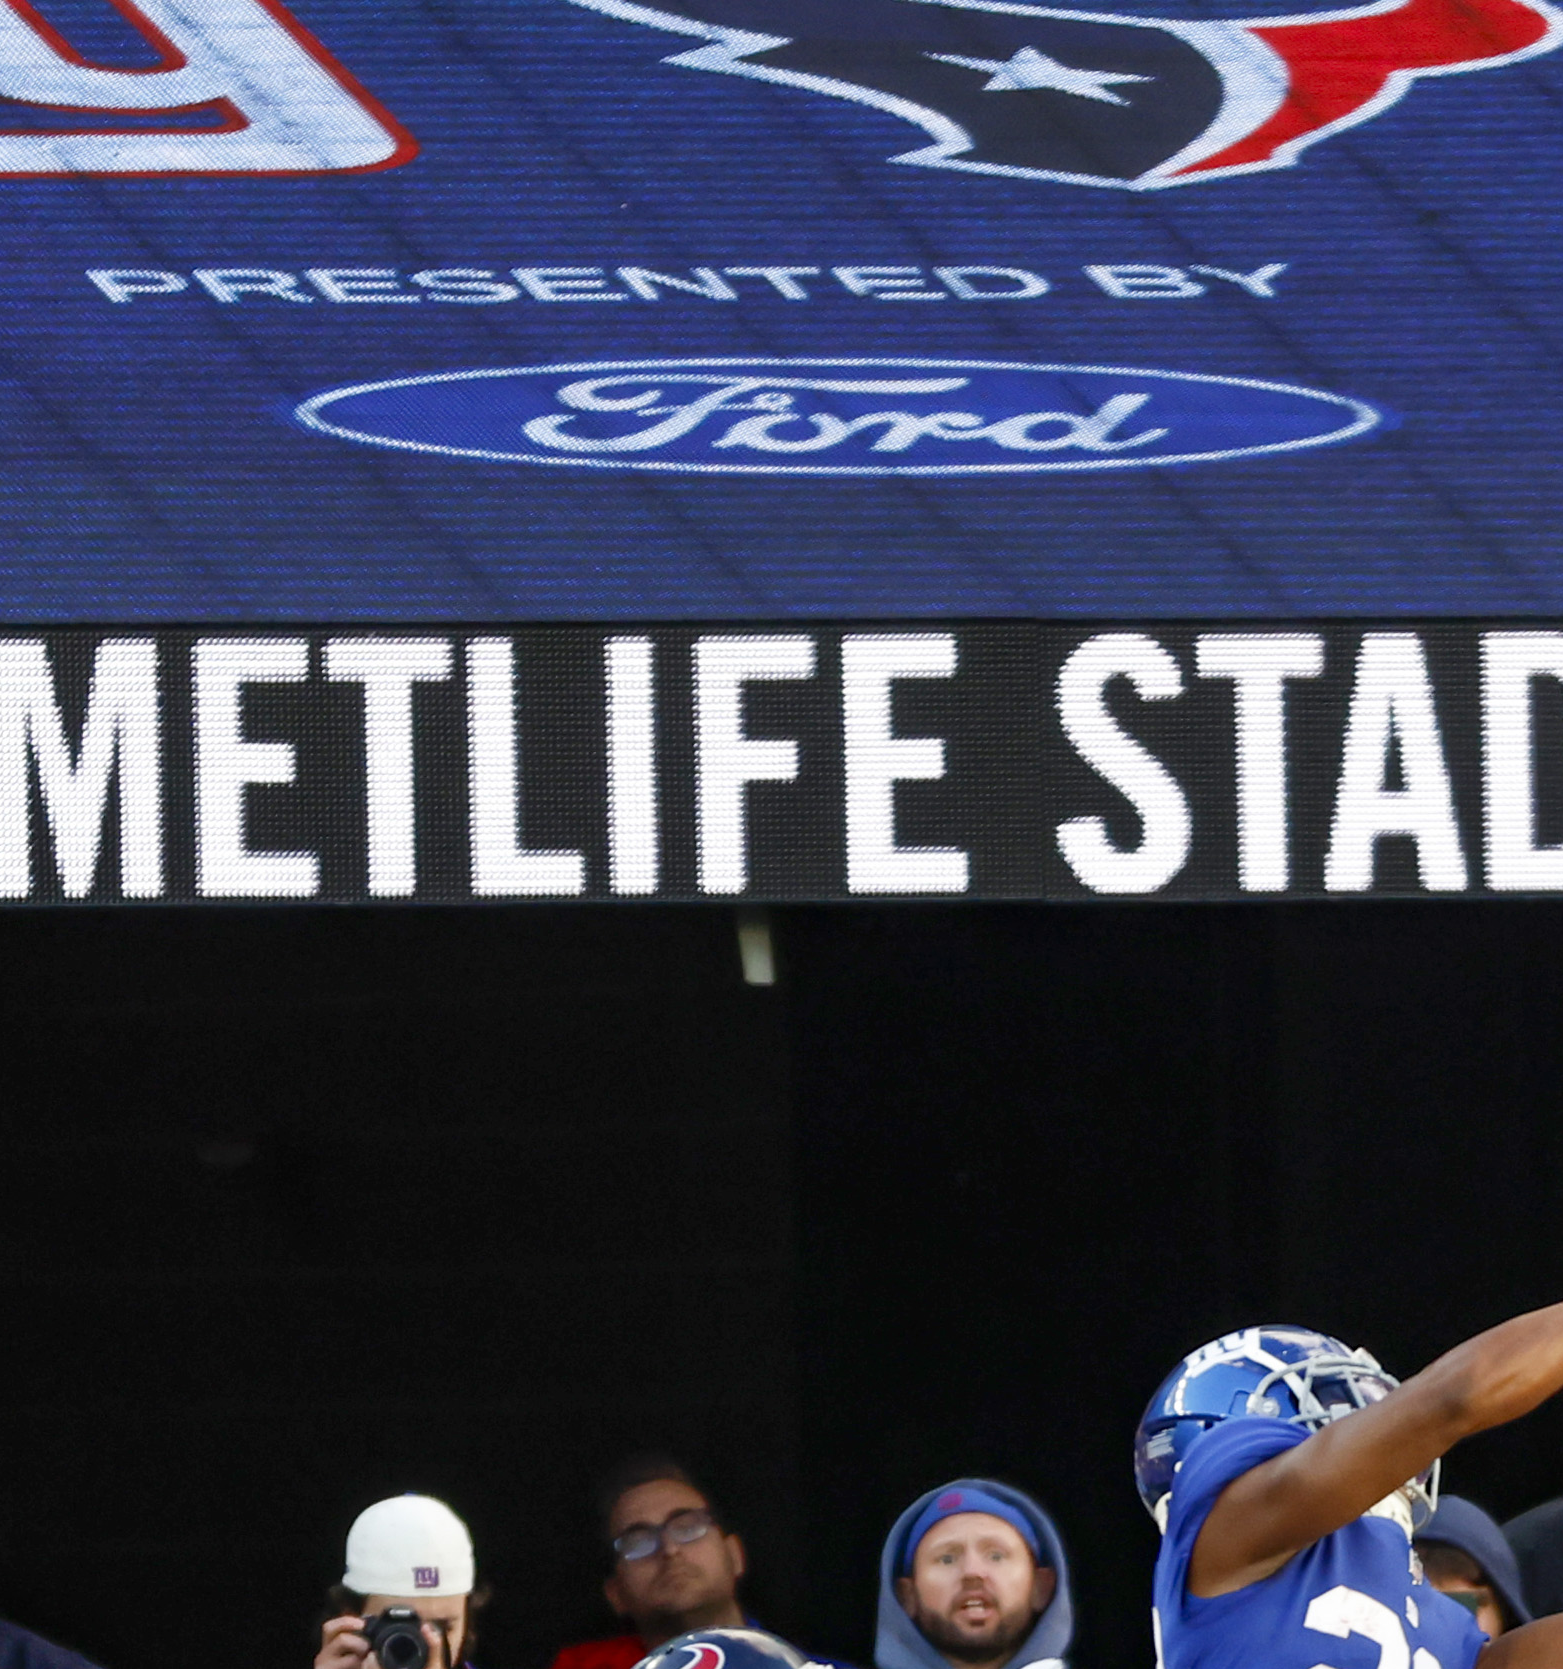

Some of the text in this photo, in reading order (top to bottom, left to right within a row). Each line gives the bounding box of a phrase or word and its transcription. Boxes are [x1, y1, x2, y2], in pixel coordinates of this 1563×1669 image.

[86, 262, 1288, 304] PRESENTED BY
[522, 374, 1169, 454] Ford
